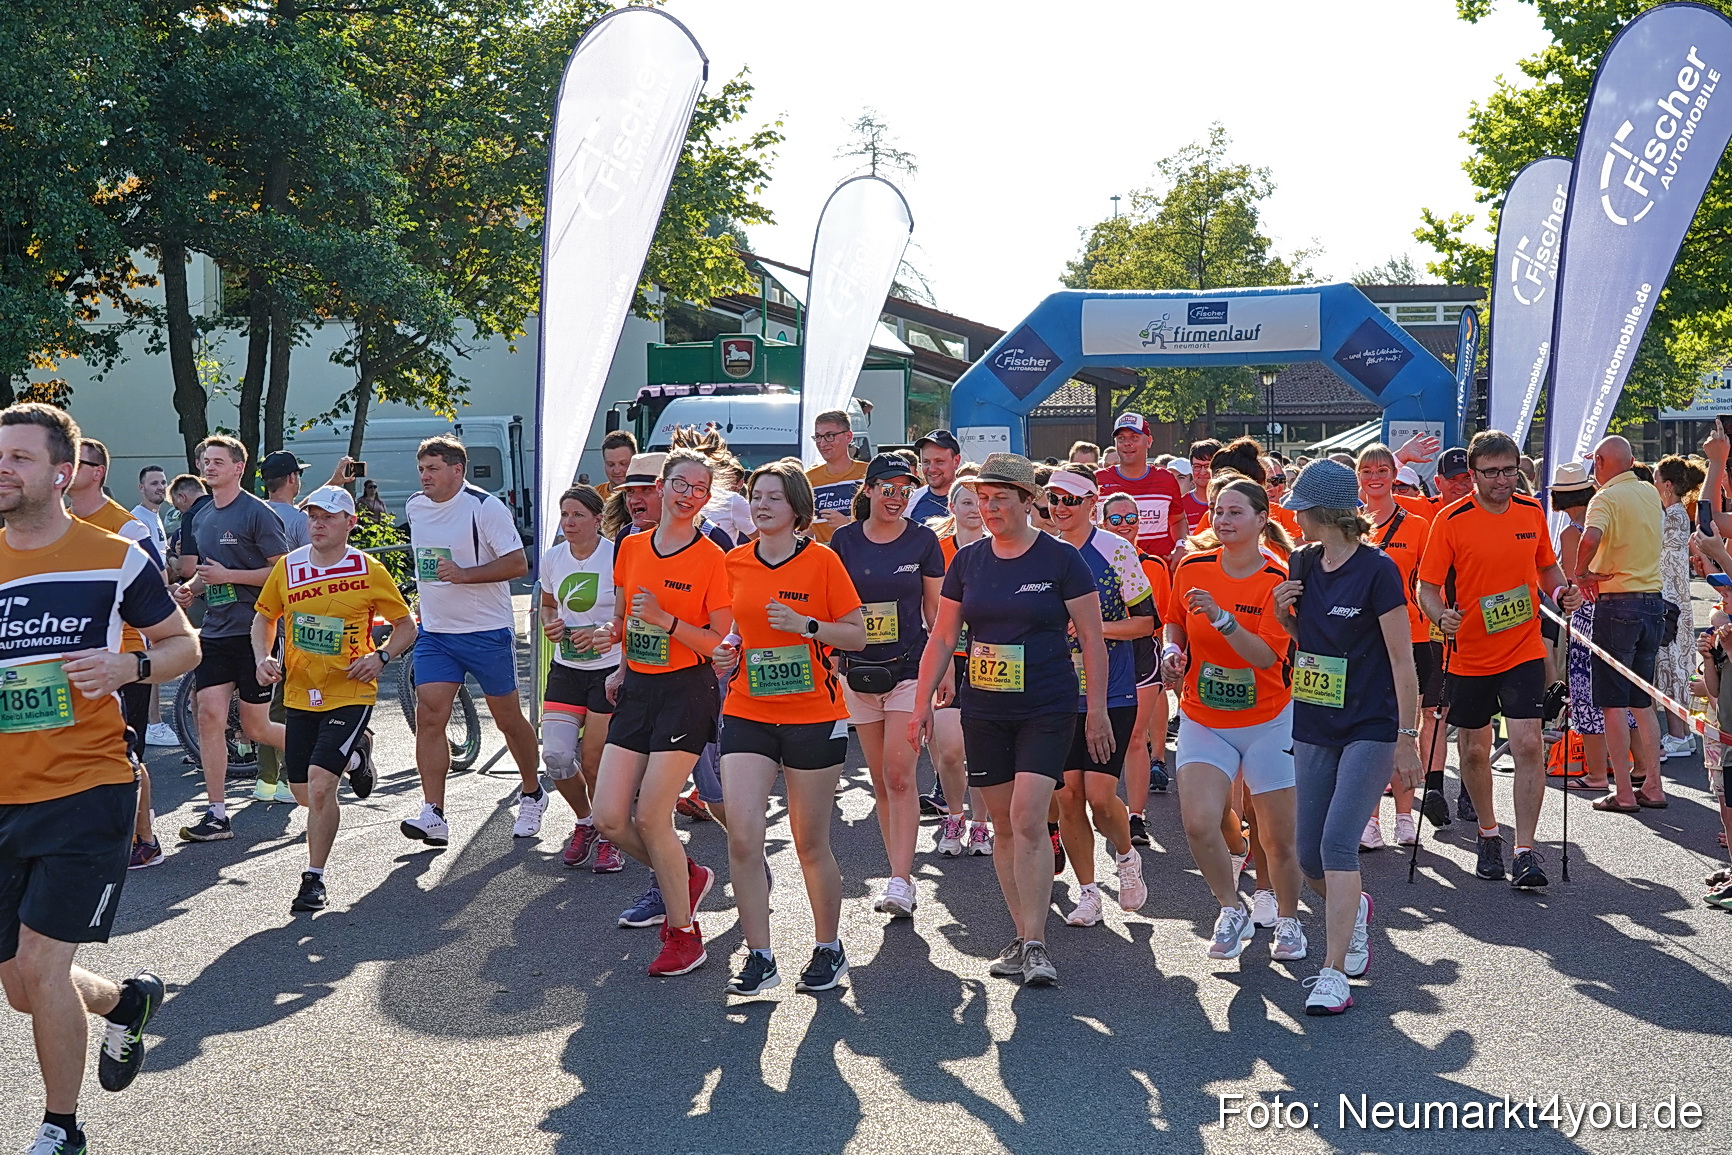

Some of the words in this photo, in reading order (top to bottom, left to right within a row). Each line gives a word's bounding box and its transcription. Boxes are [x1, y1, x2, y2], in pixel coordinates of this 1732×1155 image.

[1623, 45, 1706, 197] Fischer
[1660, 68, 1722, 191] AUTOMOBILE
[1525, 183, 1567, 286] Fischer
[1196, 309, 1226, 317] Fischer
[1173, 324, 1262, 342] firmenlauf
[1174, 342, 1210, 350] neumarkt
[1004, 356, 1051, 367] Fischer
[1515, 532, 1536, 540] THULE
[288, 586, 324, 605] MAX
[328, 579, 370, 595] BÖGL
[664, 580, 692, 592] THULE
[779, 591, 809, 602] THULE
[1235, 604, 1263, 615] THULE
[1491, 600, 1526, 620] 1419
[0, 611, 92, 638] ischer
[866, 616, 884, 631] 87
[1485, 611, 1493, 630] WALK
[299, 626, 334, 644] 1014
[628, 632, 660, 651] 1397
[757, 662, 802, 681] 1390
[802, 663, 811, 685] 2022
[980, 659, 1008, 677] 872
[750, 671, 758, 687] RUN
[977, 675, 993, 683] Kirsch
[993, 676, 1011, 684] Gerda
[1293, 670, 1301, 694] WALK
[1303, 670, 1330, 690] 873
[1206, 680, 1247, 698] 1389
[1314, 688, 1336, 699] Gabriele
[0, 686, 53, 712] 1861
[57, 688, 69, 718] 2022
[1206, 694, 1225, 703] Kirsch
[25, 709, 57, 719] Michael
